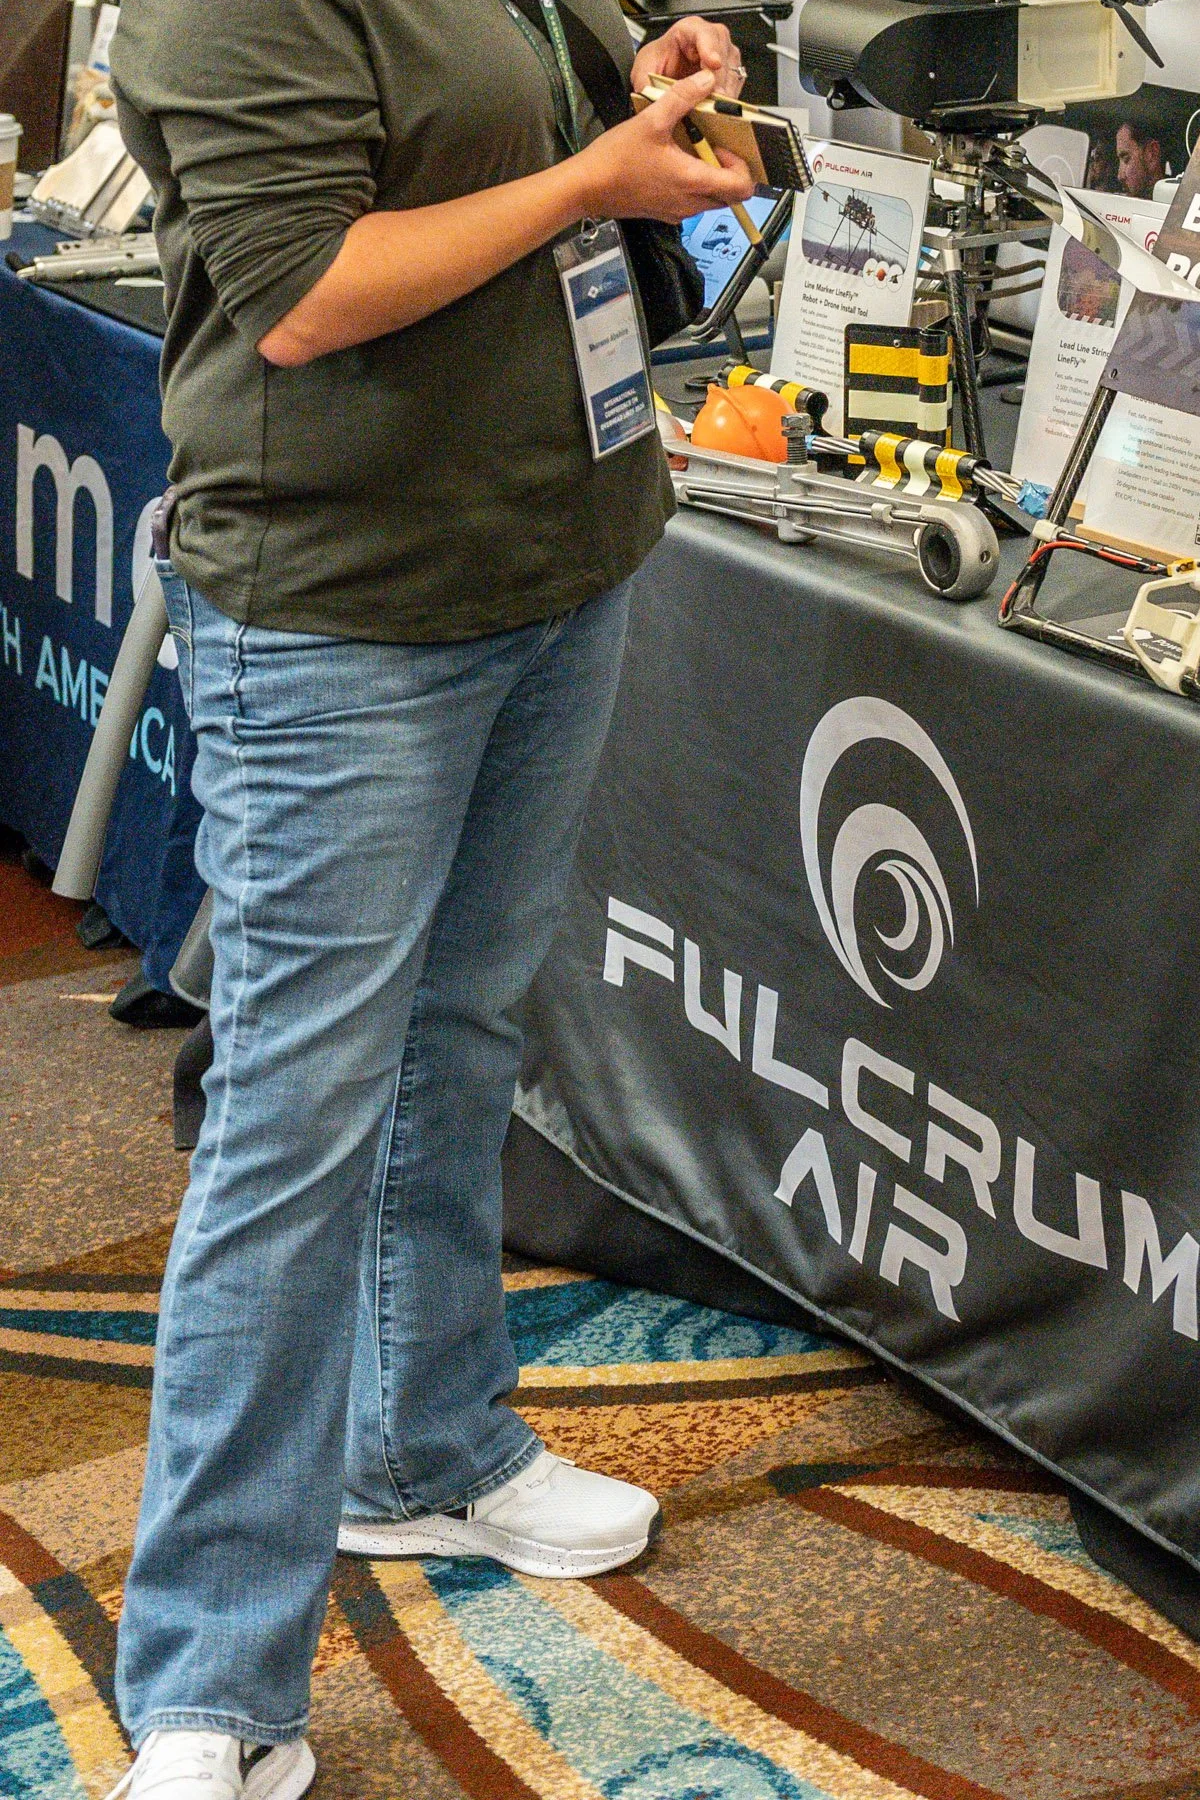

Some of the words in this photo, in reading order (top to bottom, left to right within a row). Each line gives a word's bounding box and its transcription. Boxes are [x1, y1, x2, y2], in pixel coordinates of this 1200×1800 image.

[825, 162, 860, 176] FULCRUM
[860, 170, 873, 179] AIR
[1105, 213, 1131, 224] CRUM
[804, 280, 815, 290] Line
[816, 283, 835, 295] Marker
[802, 293, 818, 304] Robot
[824, 299, 840, 311] Drone
[840, 303, 857, 314] Install
[857, 307, 869, 318] Tool
[1059, 340, 1076, 351] Lead
[1076, 343, 1090, 354] Line
[603, 896, 1200, 1342] FULCRUM
[773, 1126, 968, 1324] AIR
